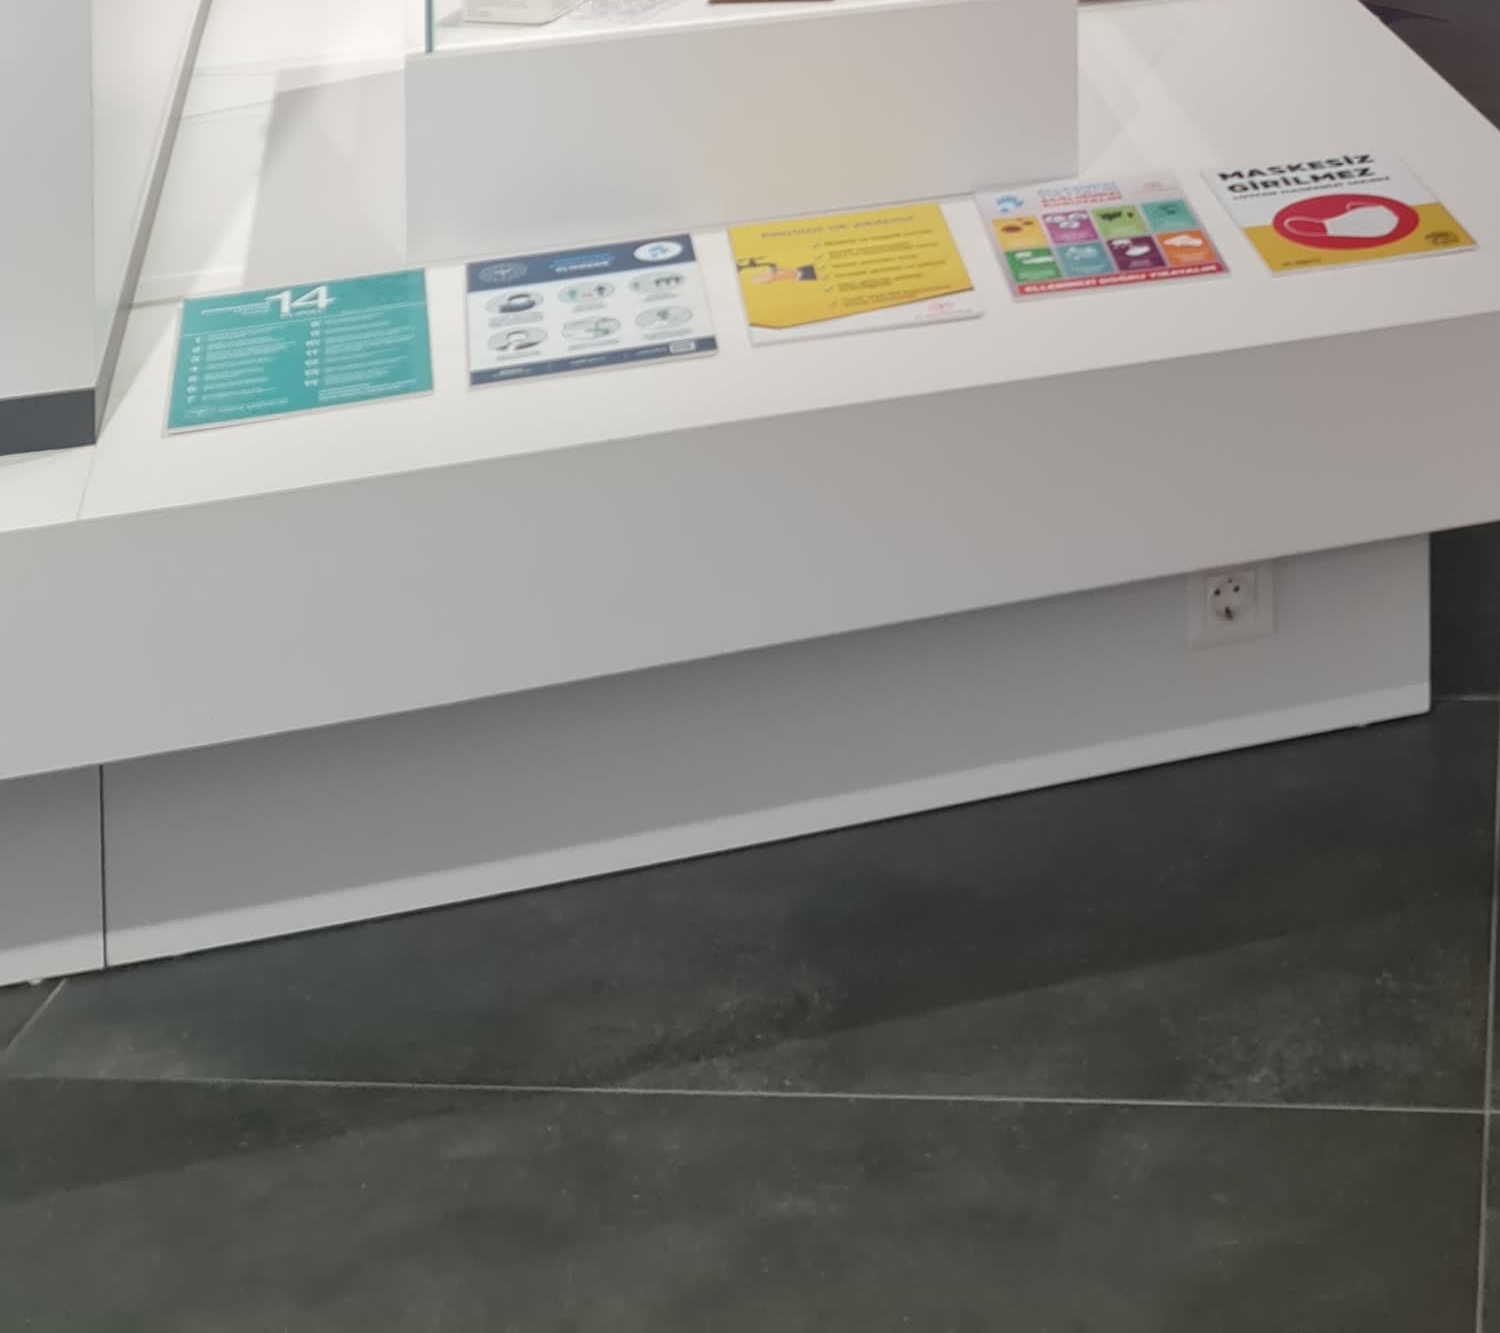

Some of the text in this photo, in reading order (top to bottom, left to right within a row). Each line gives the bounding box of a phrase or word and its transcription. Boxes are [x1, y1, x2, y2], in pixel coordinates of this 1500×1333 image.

[1217, 152, 1377, 182] MASKESİZ
[1226, 166, 1377, 195] GİRİLMEZ
[264, 283, 337, 316] 14
